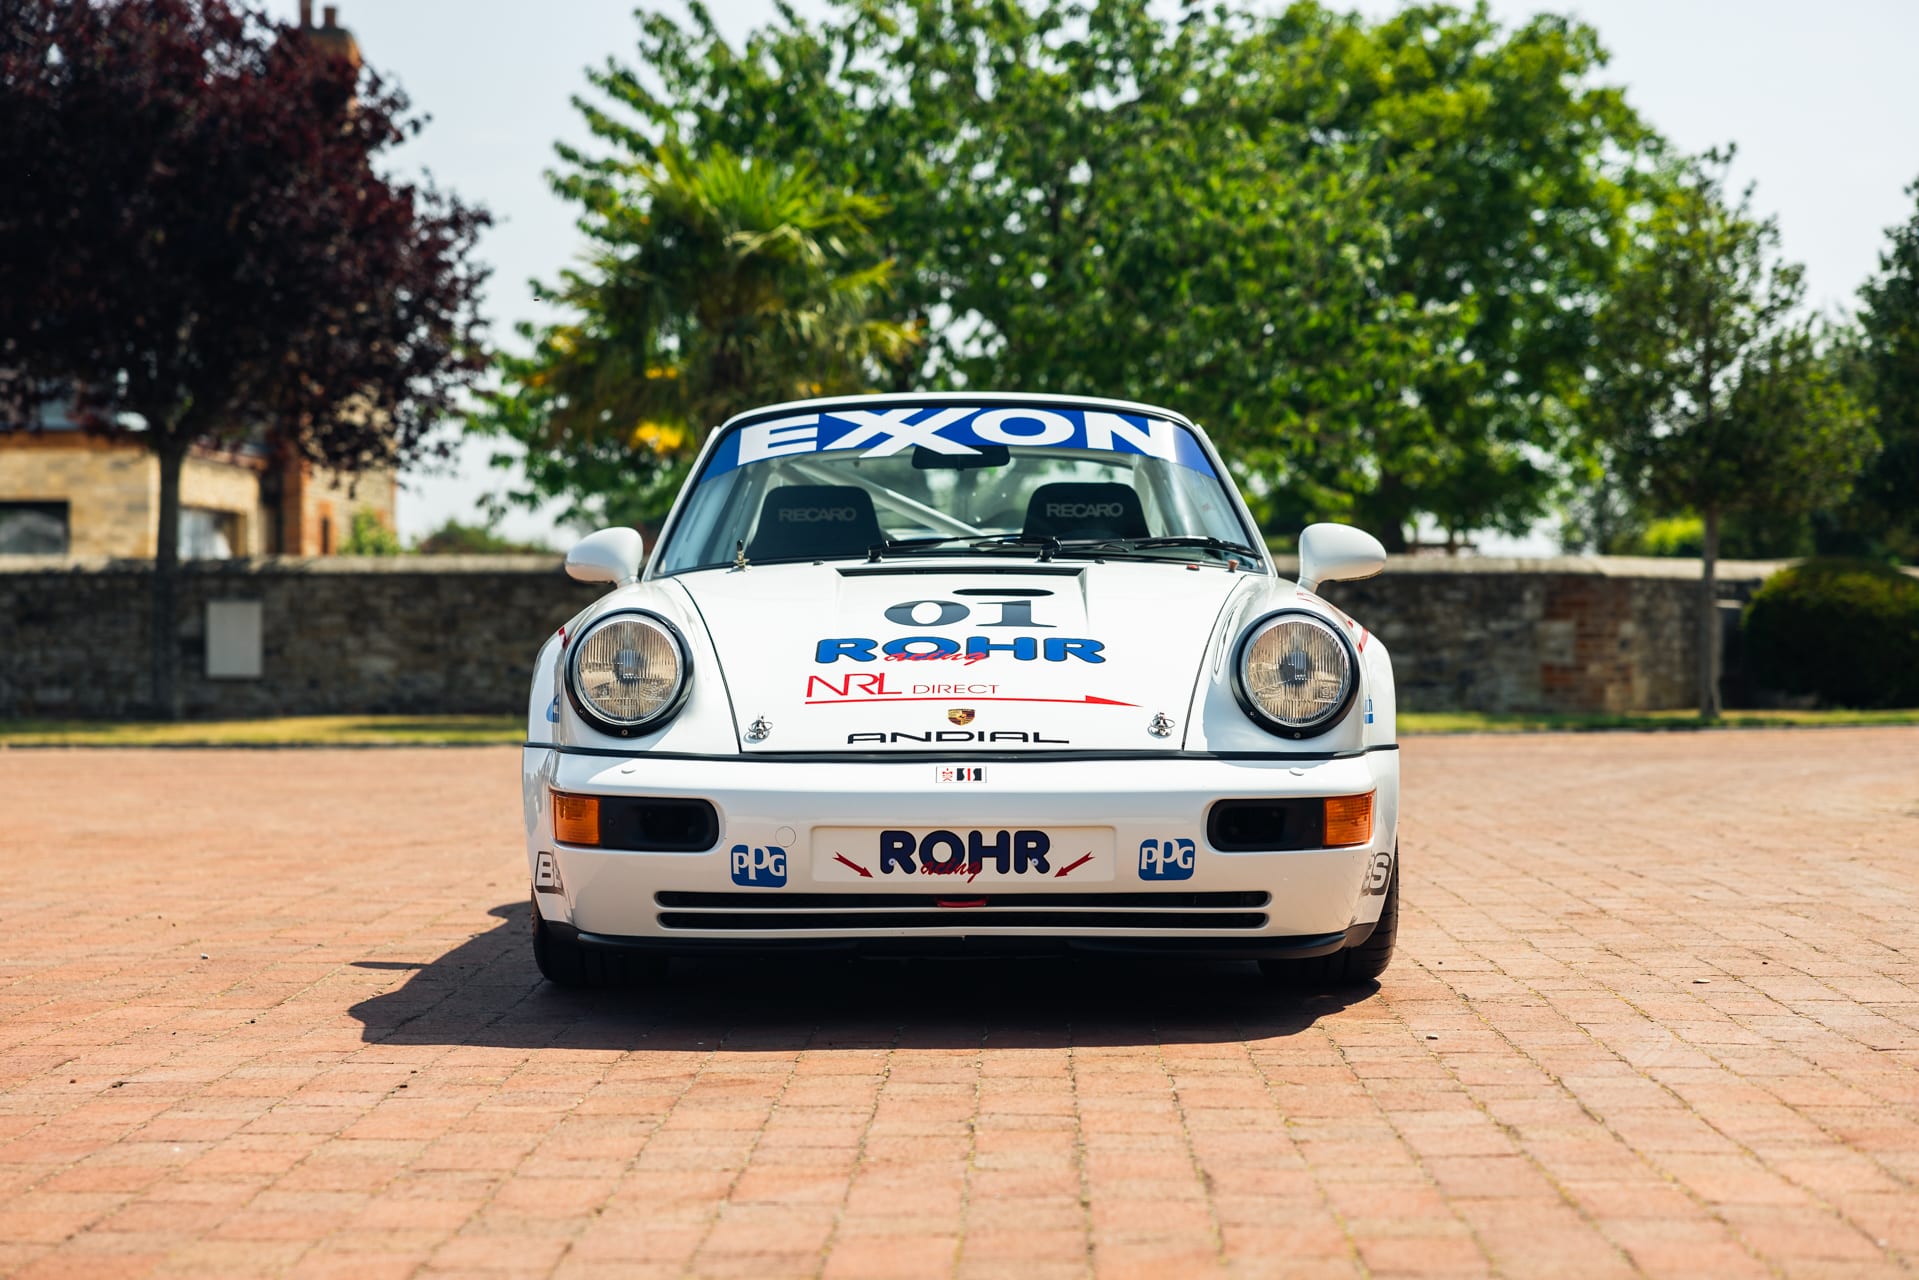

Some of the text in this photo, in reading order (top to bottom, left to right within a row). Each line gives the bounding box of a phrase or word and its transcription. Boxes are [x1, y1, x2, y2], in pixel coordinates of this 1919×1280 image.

[737, 407, 1176, 466] EXXON
[778, 508, 857, 521] RECARO
[1046, 503, 1124, 517] RECARO
[884, 600, 1057, 627] 01
[815, 636, 1106, 664] ROHR
[806, 672, 1000, 698] NRL DIRECT
[847, 731, 1070, 744] ANDIAL
[880, 830, 1050, 875] ROHR
